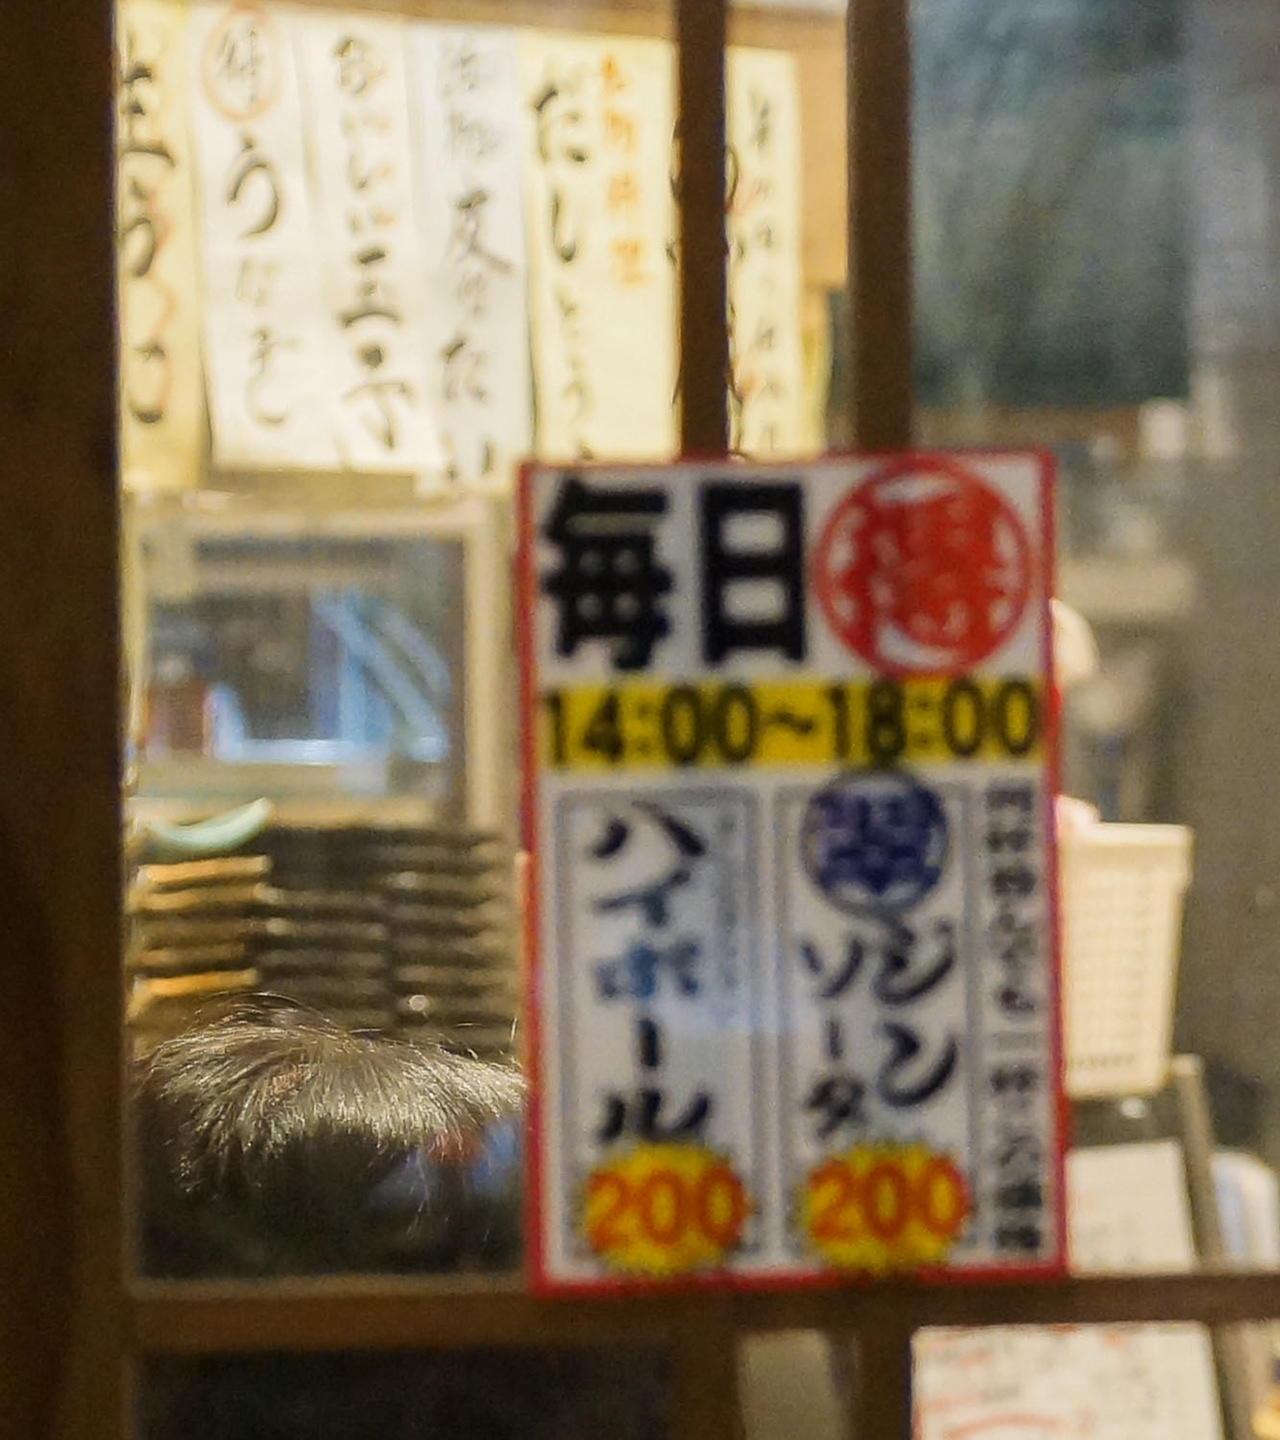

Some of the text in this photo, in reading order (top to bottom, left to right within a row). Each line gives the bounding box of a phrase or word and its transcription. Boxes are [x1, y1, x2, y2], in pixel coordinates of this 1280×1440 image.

[543, 476, 808, 672] 毎日
[586, 800, 712, 1146] ハイボール
[584, 1167, 745, 1252] 200
[806, 1158, 968, 1246] 200
